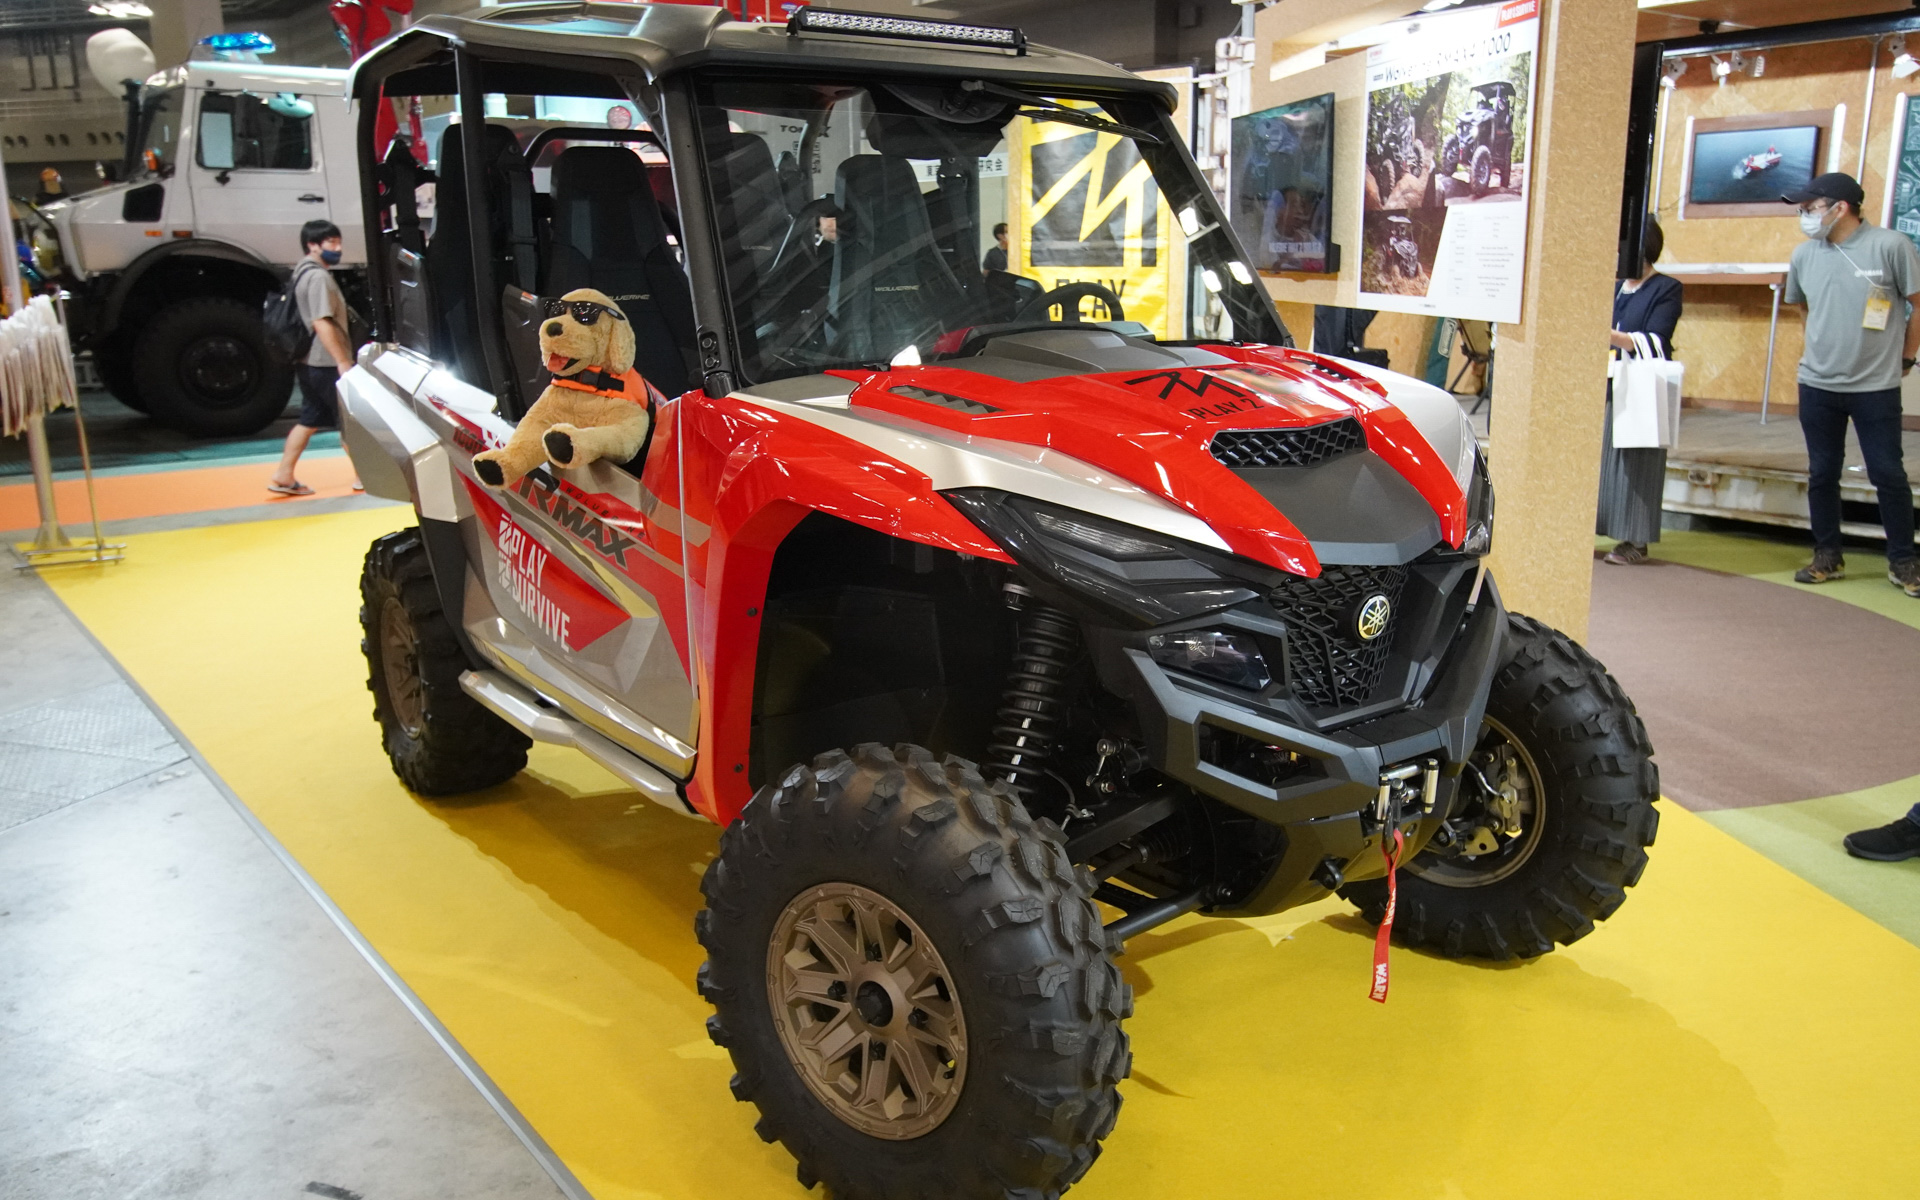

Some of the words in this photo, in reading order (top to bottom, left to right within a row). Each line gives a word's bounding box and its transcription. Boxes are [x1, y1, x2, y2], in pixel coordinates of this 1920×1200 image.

[607, 293, 650, 302] LVERINE
[1188, 401, 1245, 420] PLAY
[518, 473, 636, 570] RMAX
[565, 486, 646, 540] WOLVERNE
[511, 527, 548, 589] PLAY
[512, 568, 571, 654] SURVIVE
[1372, 962, 1388, 1001] WARN
